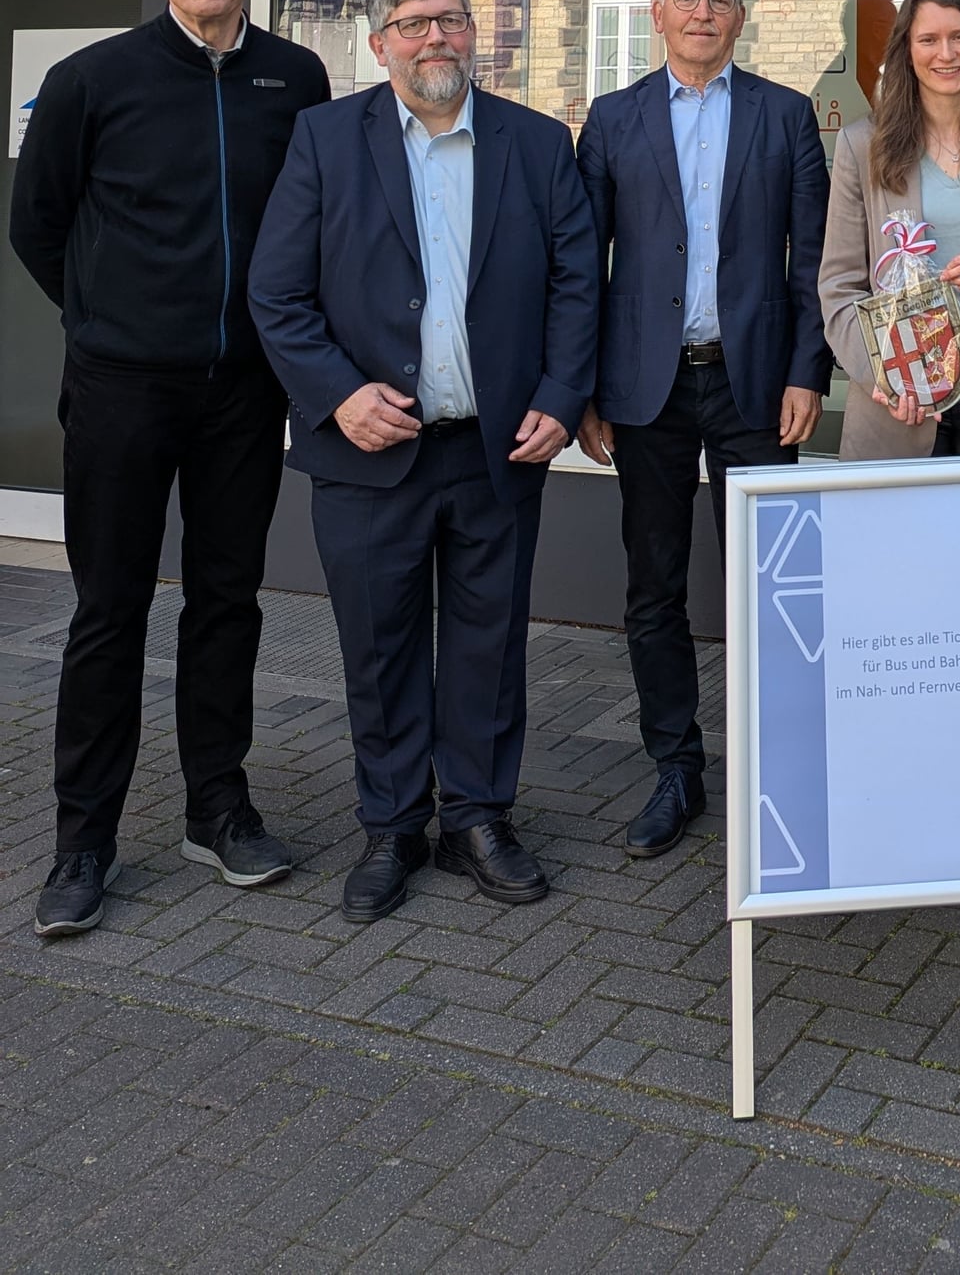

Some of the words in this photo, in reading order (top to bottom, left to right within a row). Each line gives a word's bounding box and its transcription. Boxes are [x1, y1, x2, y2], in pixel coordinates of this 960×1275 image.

[842, 636, 869, 650] Hier
[872, 634, 897, 651] gibt
[900, 636, 914, 646] es
[917, 632, 940, 645] alle
[863, 659, 881, 673] für
[885, 659, 908, 672] Bus
[911, 656, 936, 670] und
[836, 686, 852, 699] im
[856, 684, 887, 698] Nah-
[890, 682, 915, 696] und
